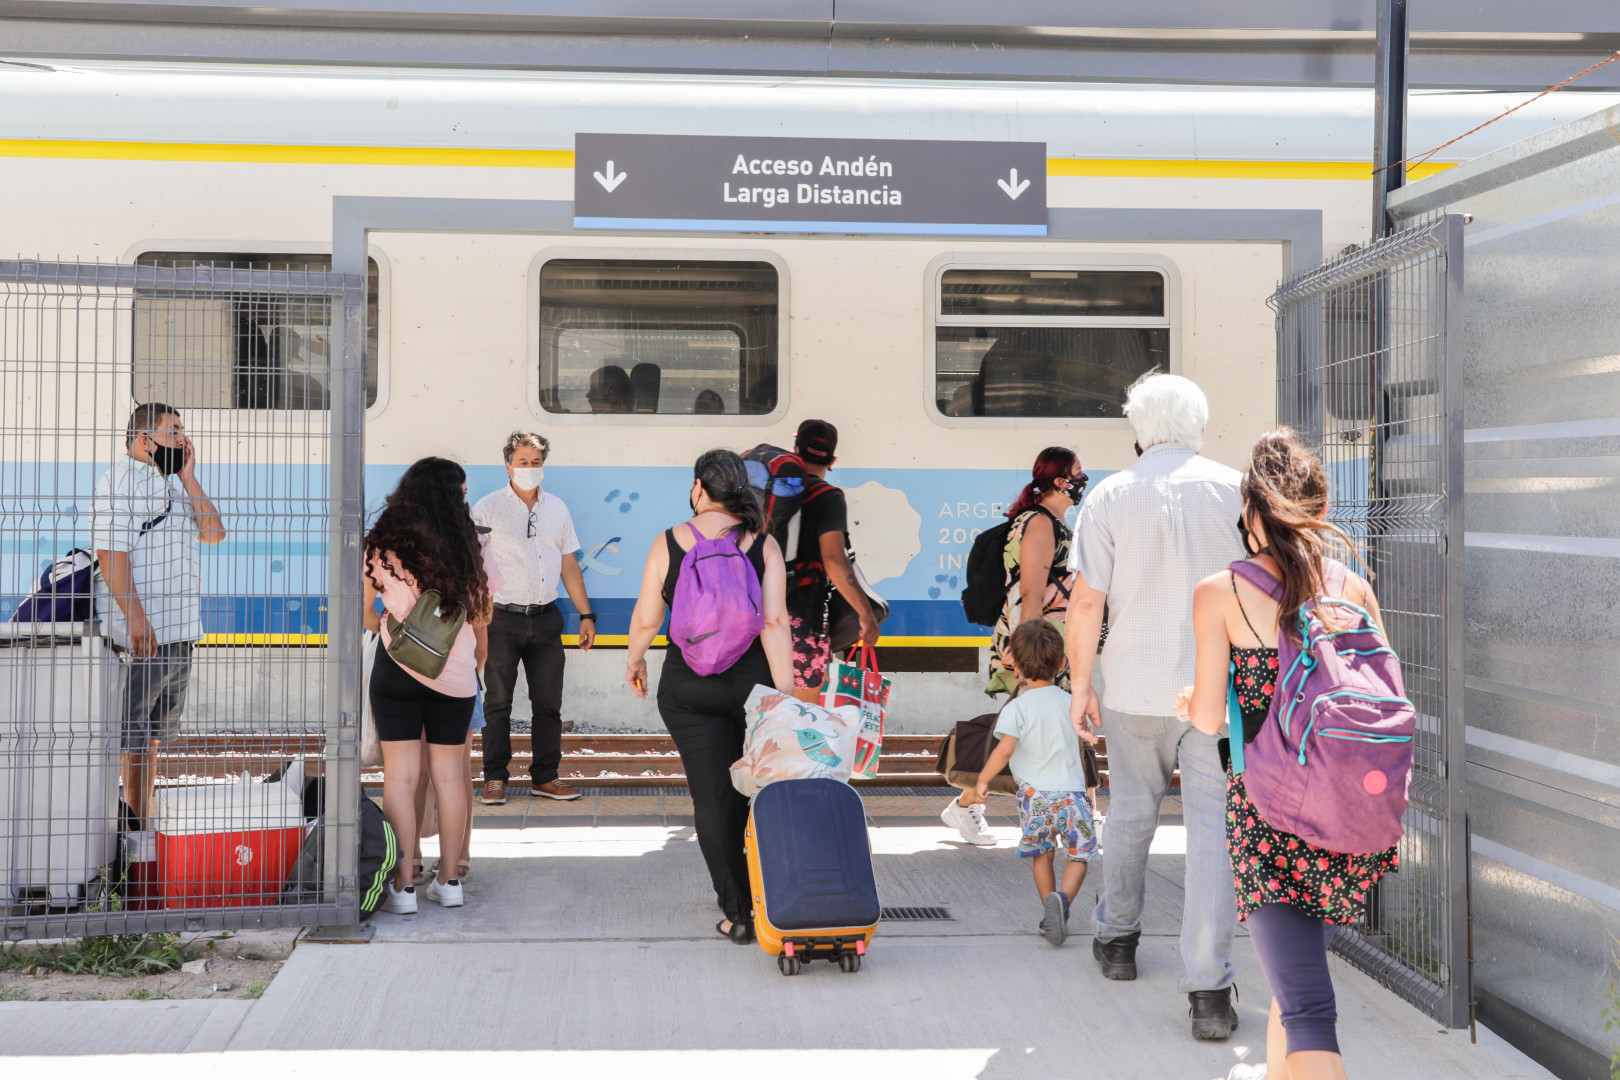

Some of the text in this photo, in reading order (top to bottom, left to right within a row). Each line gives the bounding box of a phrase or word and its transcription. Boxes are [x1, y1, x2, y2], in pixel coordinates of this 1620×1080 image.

[732, 154, 893, 177] Acceso Andén
[723, 182, 902, 208] Larga Distancia
